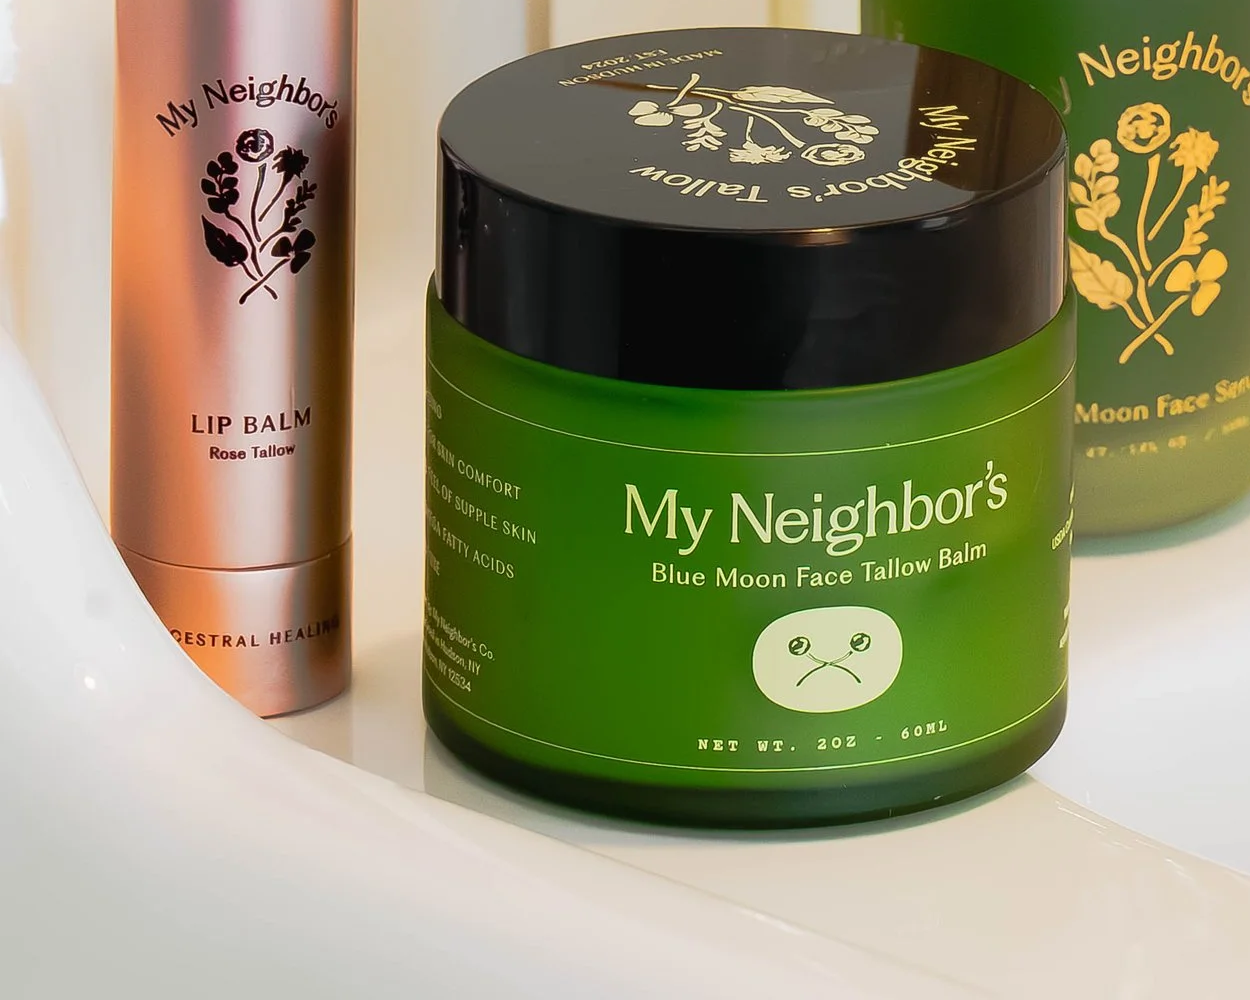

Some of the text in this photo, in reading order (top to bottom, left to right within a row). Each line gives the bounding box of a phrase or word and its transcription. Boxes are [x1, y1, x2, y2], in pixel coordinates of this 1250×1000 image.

[558, 48, 723, 88] MADE IN HUDSON
[581, 55, 630, 70] 2024
[155, 73, 339, 138] My Neighbor's
[629, 104, 978, 203] My Neighbor's Tallow
[191, 406, 312, 436] LIP BALM
[1074, 401, 1149, 425] Moon
[1156, 391, 1211, 419] Face
[208, 443, 296, 461] Rose Tallow
[437, 440, 456, 468] SKIN
[457, 459, 522, 500] COMFORT
[441, 484, 454, 504] OF
[455, 495, 499, 531] SUPPLE
[502, 519, 537, 545] SKIN
[622, 459, 1009, 558] My Neighbor's
[442, 526, 470, 559] FATTY
[472, 550, 515, 579] ACIDS
[651, 541, 988, 590] Blue Moon Face Tallow Balm
[441, 616, 478, 654] Neighbor's
[479, 644, 495, 662] Co.
[468, 659, 481, 676] NY
[697, 738, 739, 753] NET
[757, 739, 797, 753] WT.
[900, 719, 949, 742] 60ML
